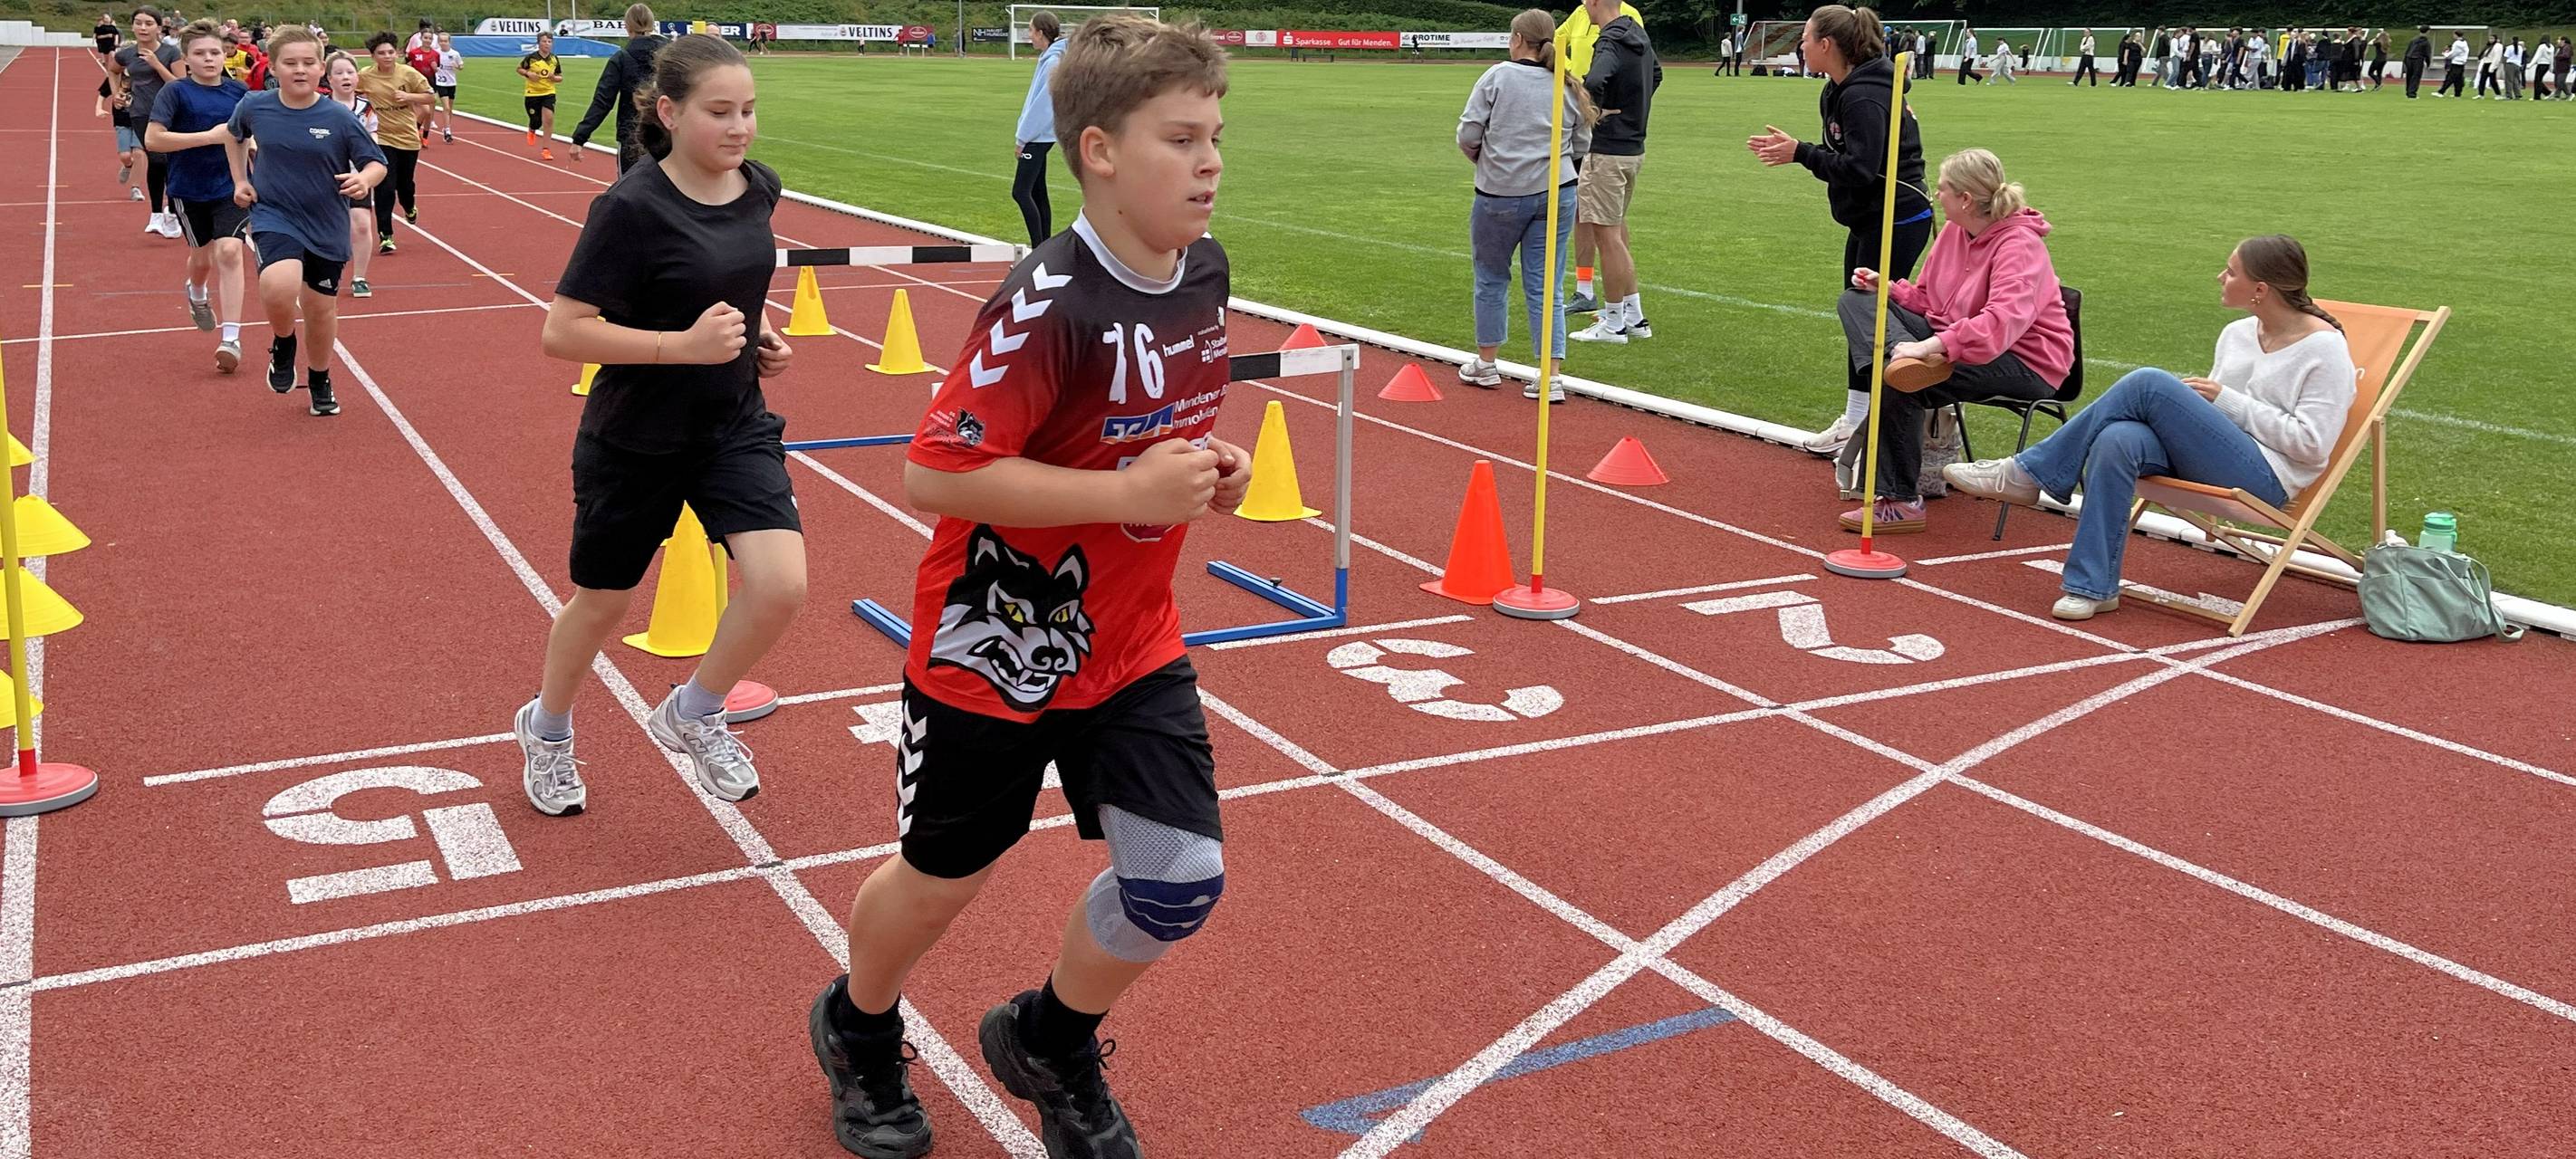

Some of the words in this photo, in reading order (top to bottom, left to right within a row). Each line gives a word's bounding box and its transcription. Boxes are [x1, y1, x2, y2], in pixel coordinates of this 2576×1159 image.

[499, 21, 541, 33] VELTINS
[849, 26, 893, 38] VELTINS
[1338, 38, 1350, 46] Gut
[1351, 38, 1362, 46] für
[1162, 334, 1195, 358] hummel
[1679, 590, 1946, 664] 2
[1326, 638, 1564, 722] 3
[262, 766, 524, 905] 5
